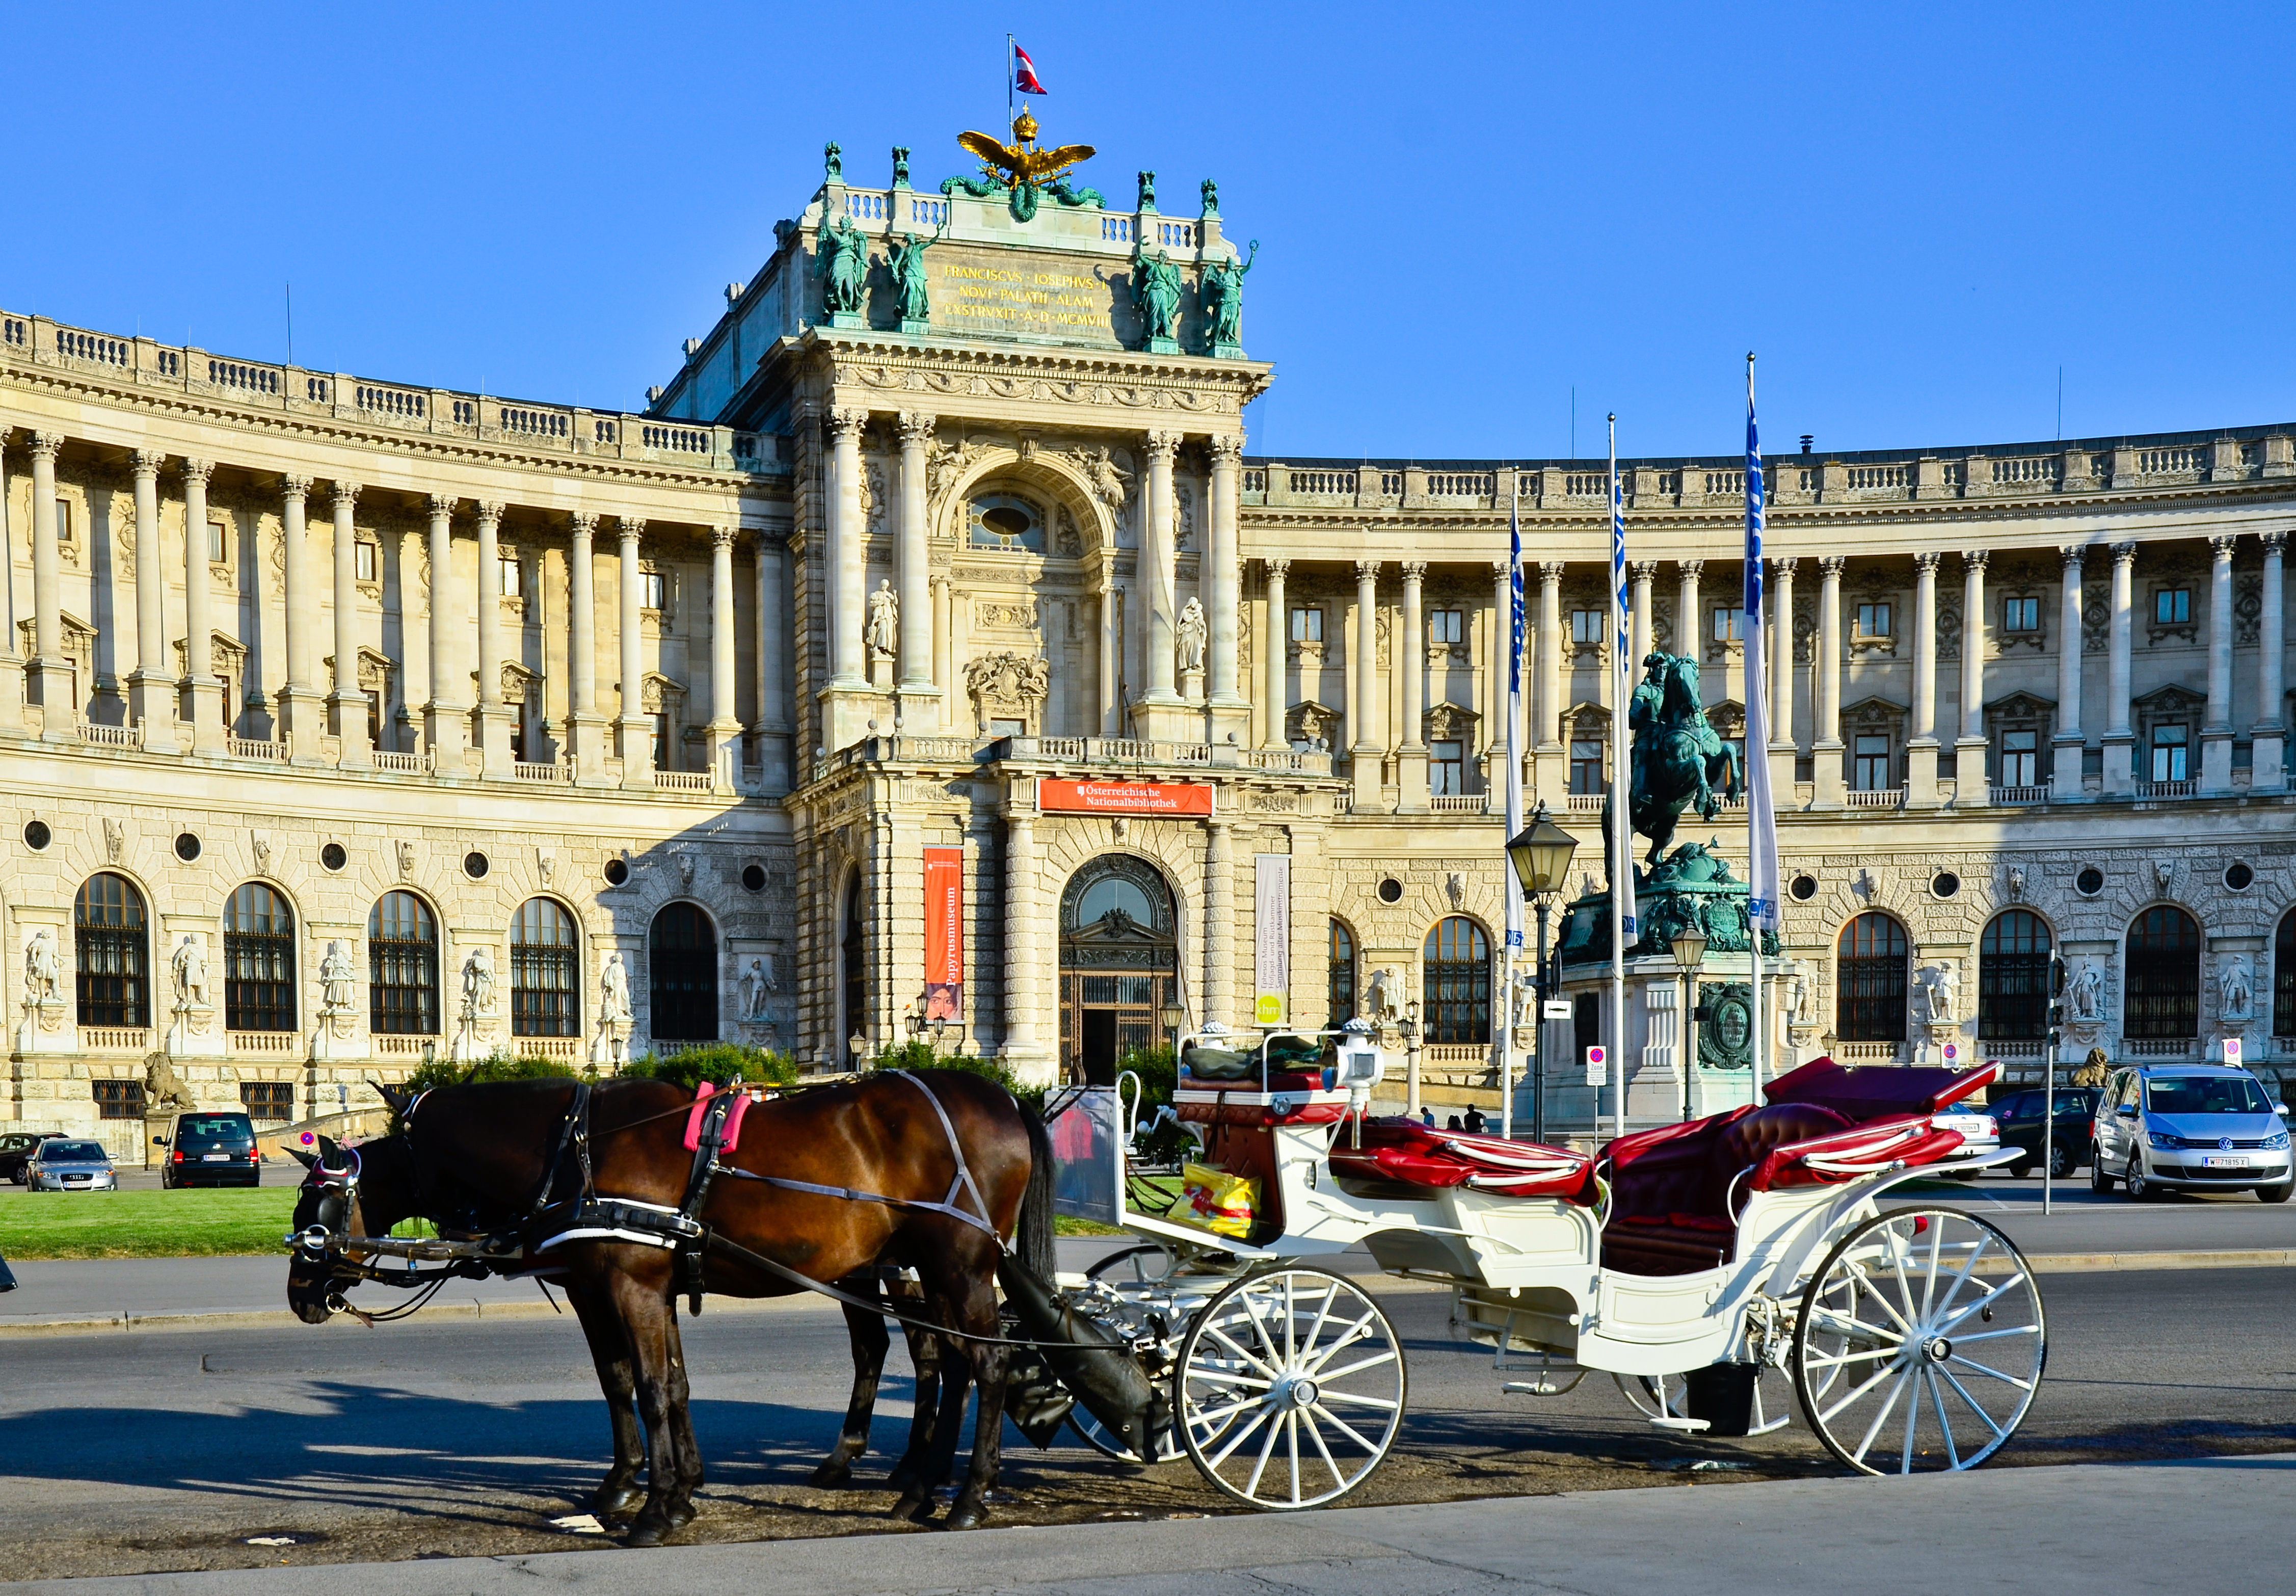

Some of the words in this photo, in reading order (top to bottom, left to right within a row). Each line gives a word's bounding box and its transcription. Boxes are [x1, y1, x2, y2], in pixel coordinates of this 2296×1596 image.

[945, 265, 1023, 282] FRANCISCVS
[1034, 274, 1093, 289] IOSEPHVS
[959, 285, 992, 299] NOVI
[1000, 289, 1048, 304] PALATII
[1056, 294, 1094, 308] ALAM
[945, 303, 1017, 320] EXSTRVXIT
[1024, 310, 1033, 321] A
[1040, 311, 1049, 322] D
[1056, 312, 1109, 328] MCMVIII
[1086, 785, 1160, 796] Österreichische
[1086, 797, 1177, 808] Nationalbibliothek
[946, 887, 958, 986] Papyrusmuseum
[1276, 951, 1285, 989] Sammlung
[1257, 1004, 1280, 1015] khm
